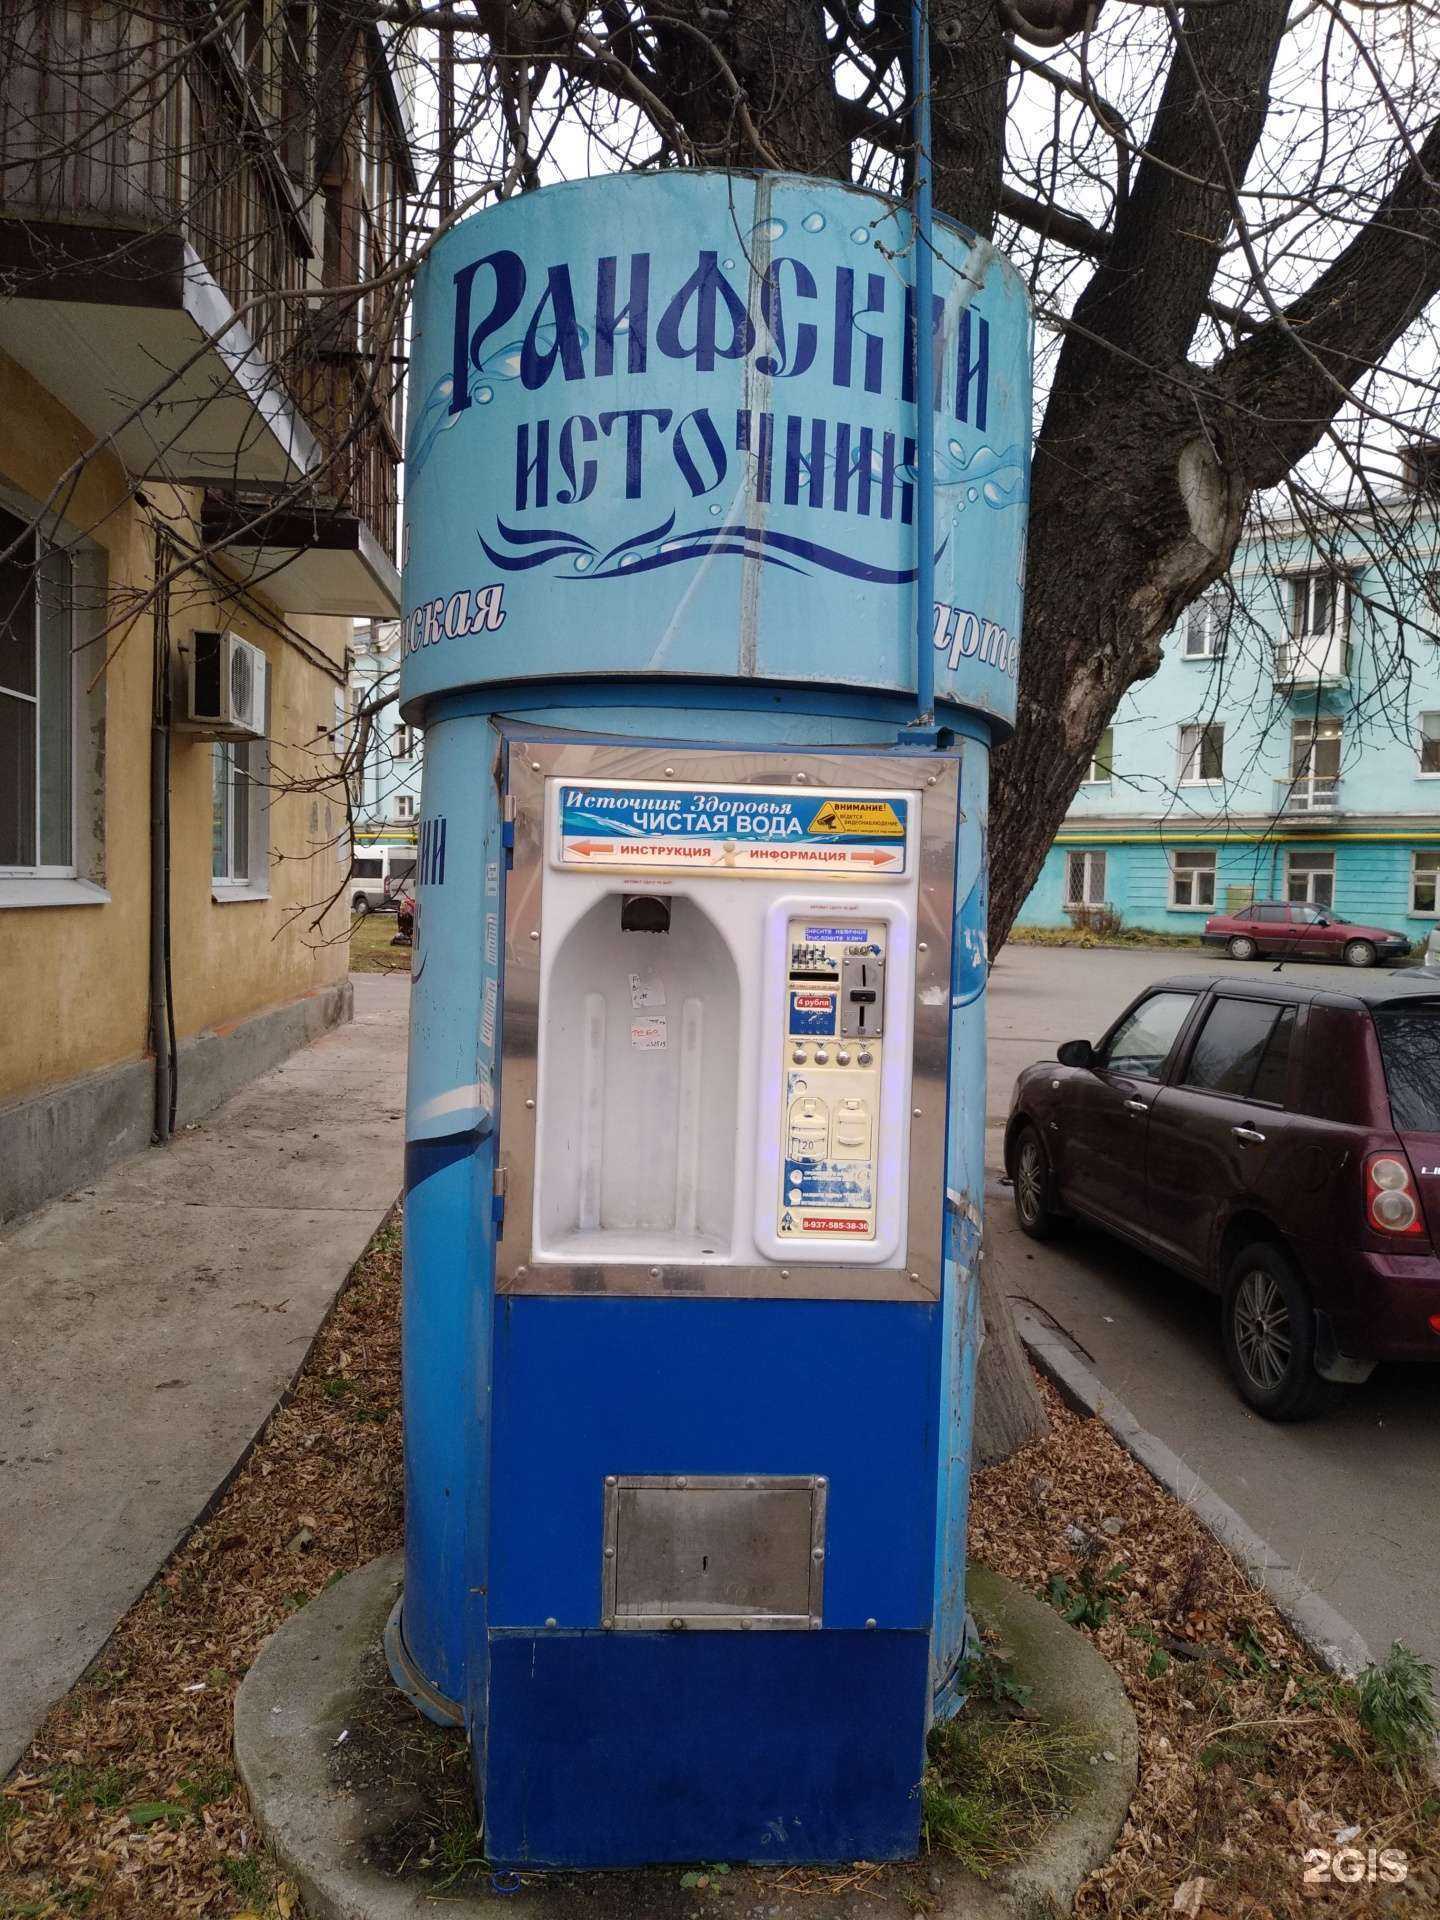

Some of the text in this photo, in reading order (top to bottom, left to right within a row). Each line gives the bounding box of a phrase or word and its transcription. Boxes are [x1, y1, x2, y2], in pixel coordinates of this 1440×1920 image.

[402, 583, 507, 658] ская
[566, 791, 793, 818] Источник Здоровья
[834, 803, 887, 812] ВНИМАНИЕ!
[632, 812, 803, 837] ЧИСТАЯ ВОДА
[620, 845, 847, 862] ИНСТРУКЦИЯ ИНФОРМАЦИЯ
[798, 997, 829, 1007] 4 рубля
[802, 1141, 814, 1149] 20
